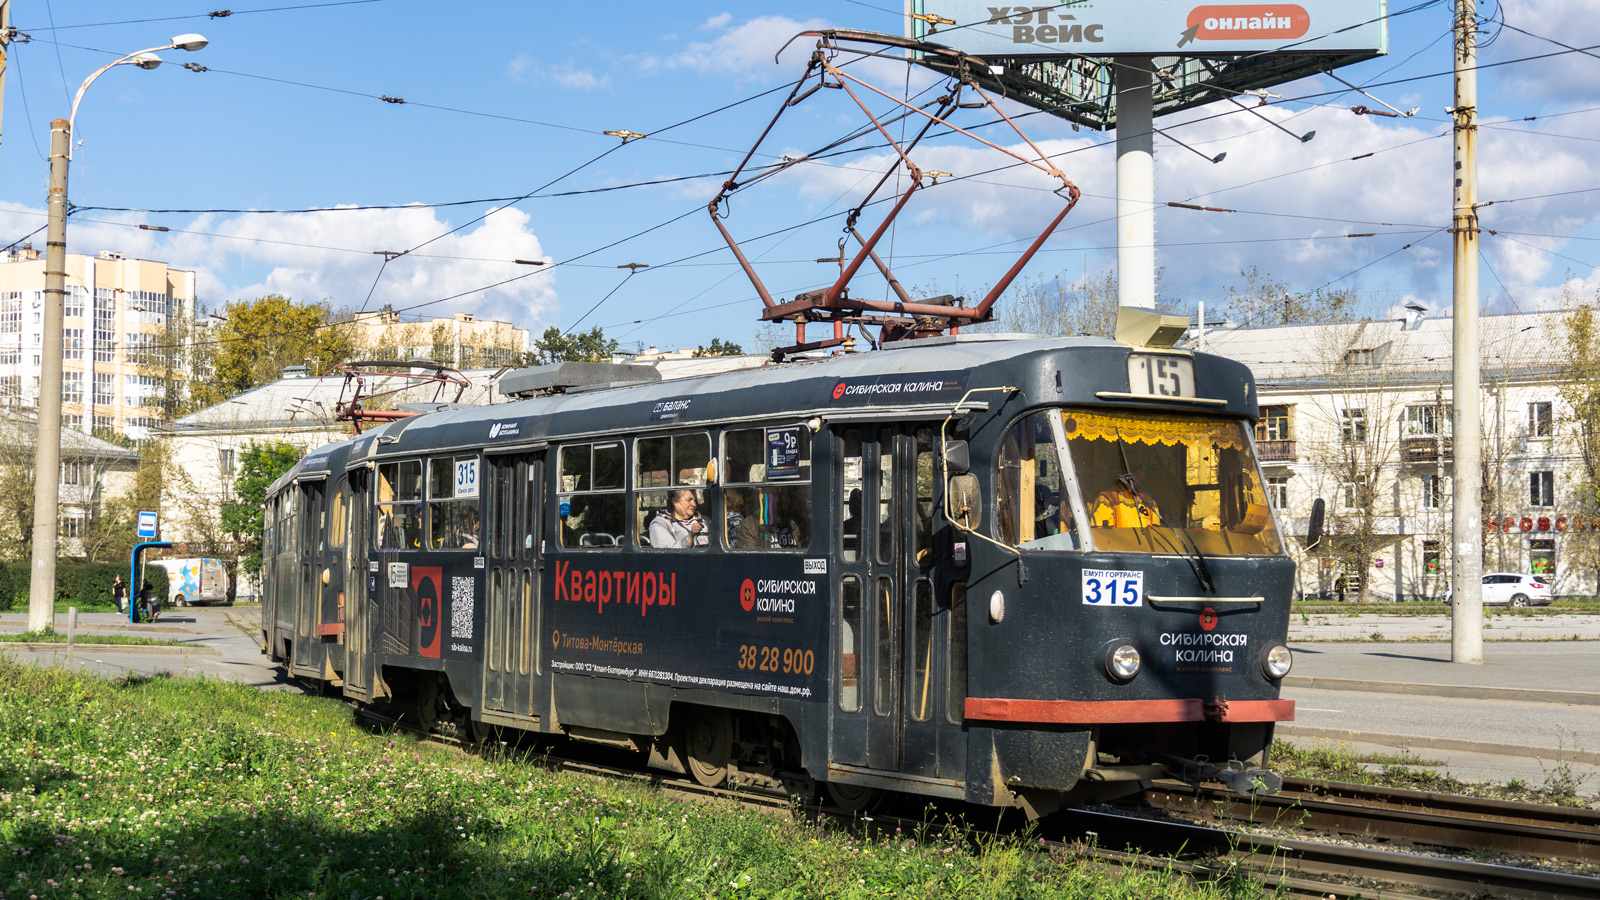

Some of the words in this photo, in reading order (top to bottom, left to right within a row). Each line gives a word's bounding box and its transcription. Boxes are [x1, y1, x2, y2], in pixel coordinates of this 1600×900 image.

[1204, 12, 1291, 30] онлайн
[1141, 358, 1180, 396] 15
[458, 462, 475, 485] 315
[805, 561, 826, 571] ВЫХОД
[555, 560, 676, 617] Квартиры
[1085, 578, 1138, 605] 315
[562, 633, 643, 656] Титова-Монтёрская
[738, 644, 757, 670] 38
[759, 646, 779, 672] 28
[782, 648, 815, 675] 900
[674, 673, 698, 683] Проектная
[726, 680, 753, 690] размещена
[754, 682, 761, 690] на
[761, 682, 777, 692] сайте
